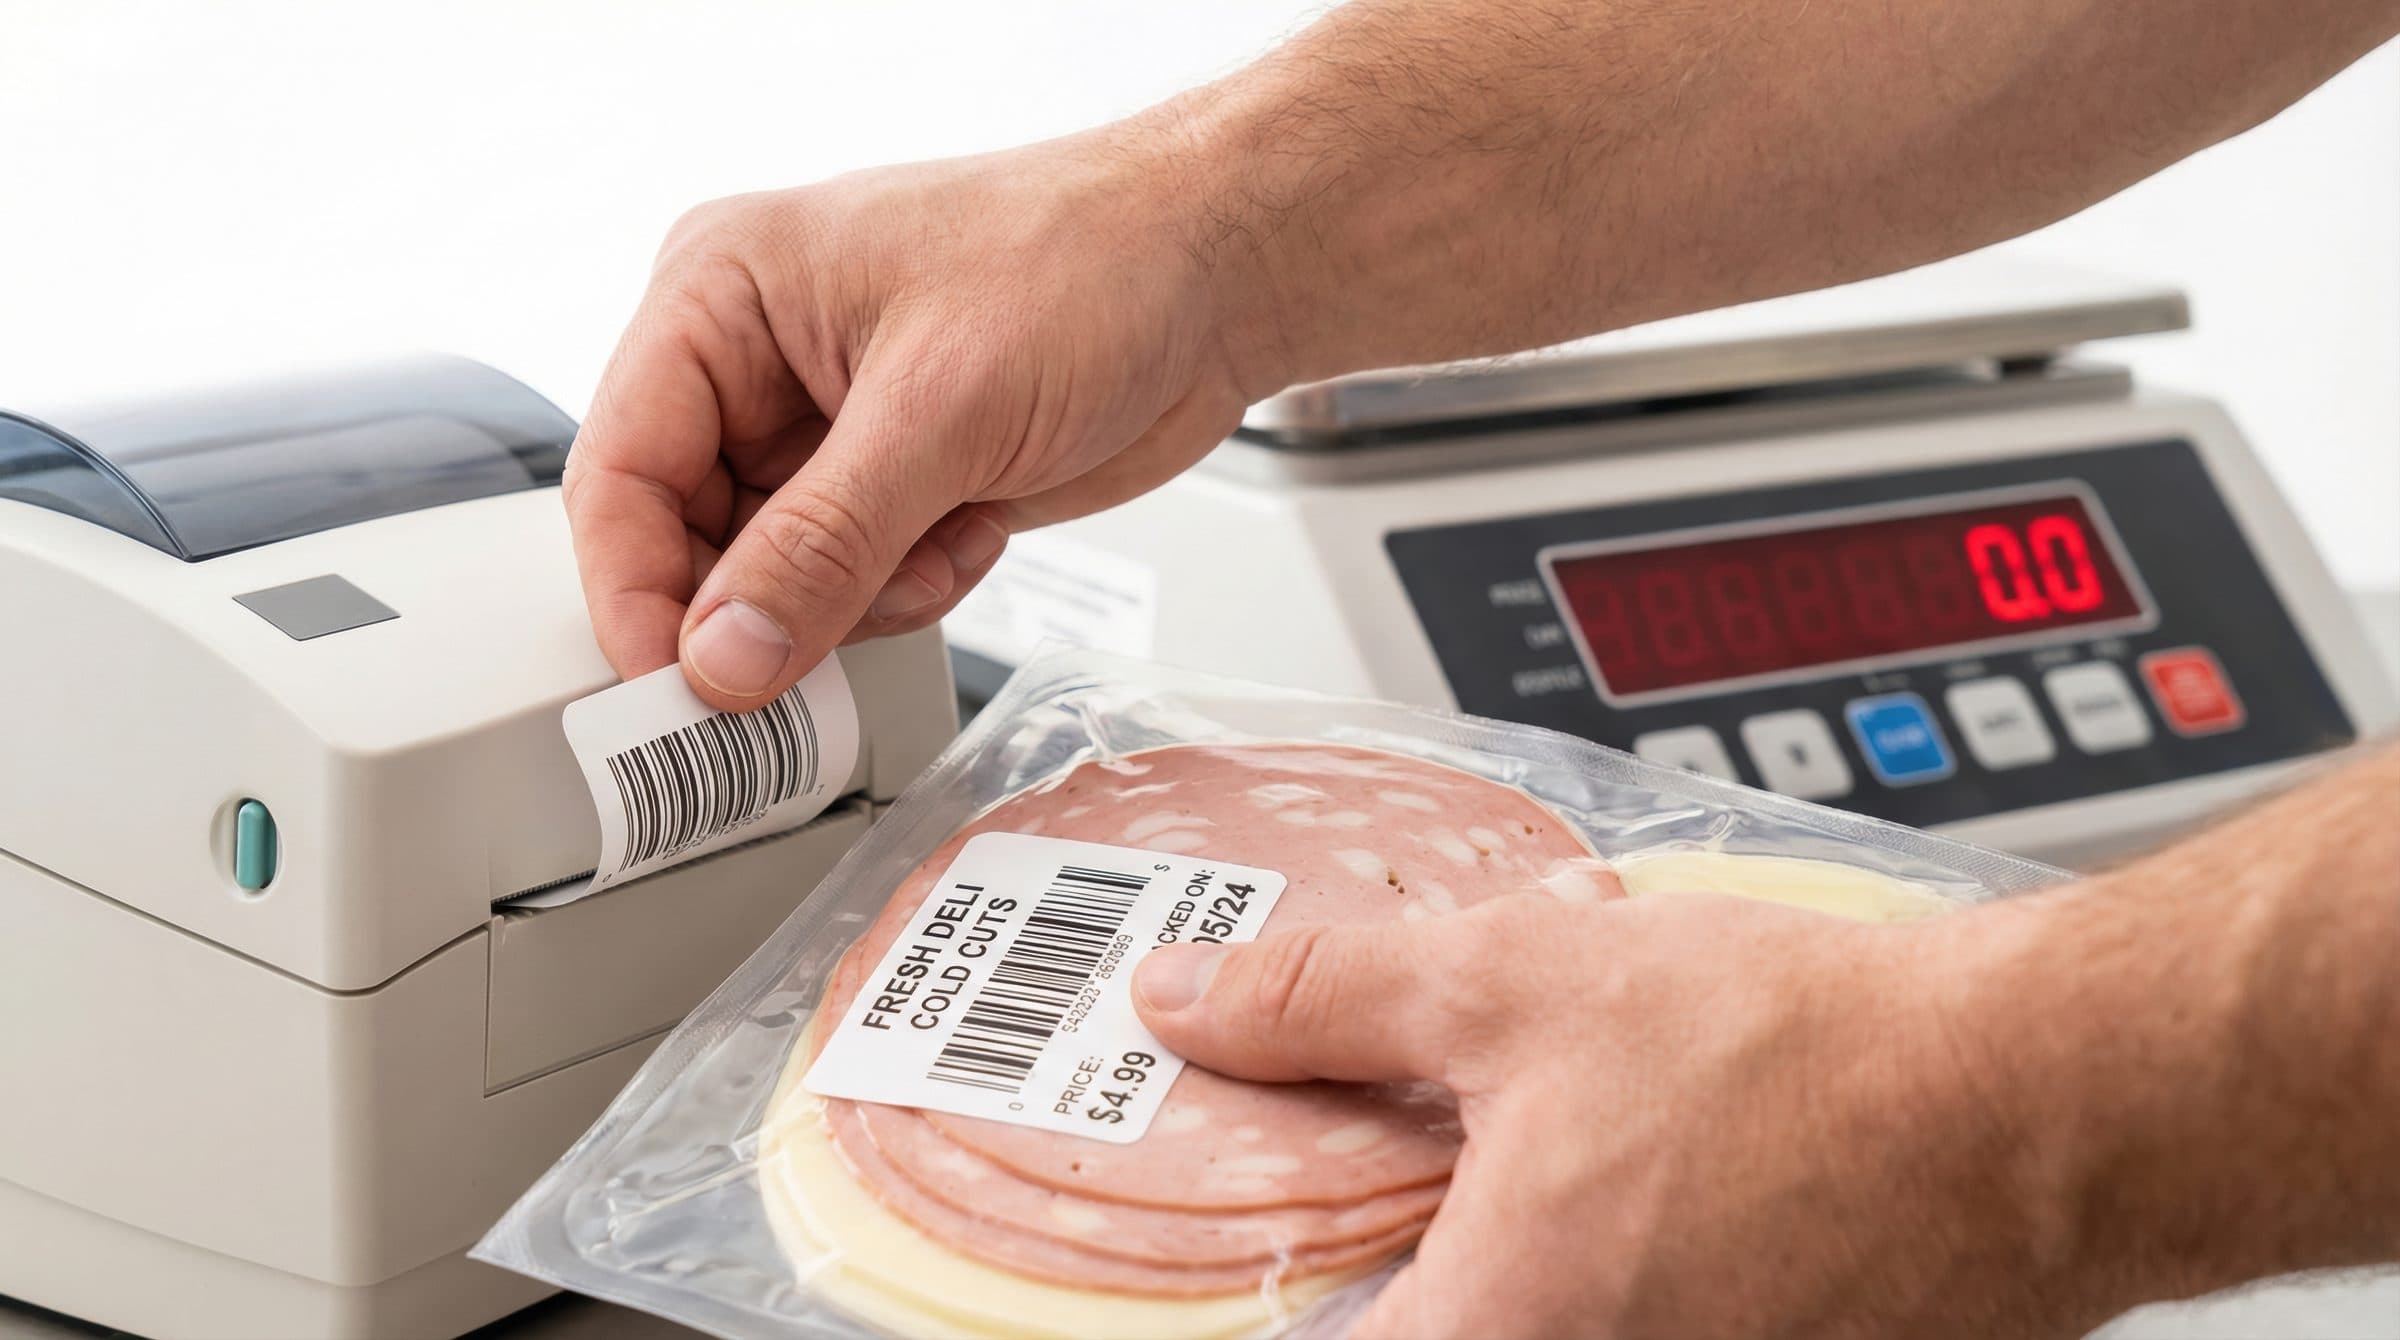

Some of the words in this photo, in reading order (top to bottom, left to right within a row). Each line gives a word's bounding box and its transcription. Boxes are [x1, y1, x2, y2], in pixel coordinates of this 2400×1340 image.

[1965, 515, 2104, 621] 0.0
[1151, 900, 1195, 950] CKED
[1185, 869, 1216, 897] ON:
[861, 945, 942, 1030] FRESH
[922, 884, 984, 939] DELI
[910, 965, 971, 1030] COLD
[958, 898, 1018, 958] CUTS
[1053, 1056, 1104, 1115] PRICE:
[1087, 1051, 1156, 1124] $4.99
